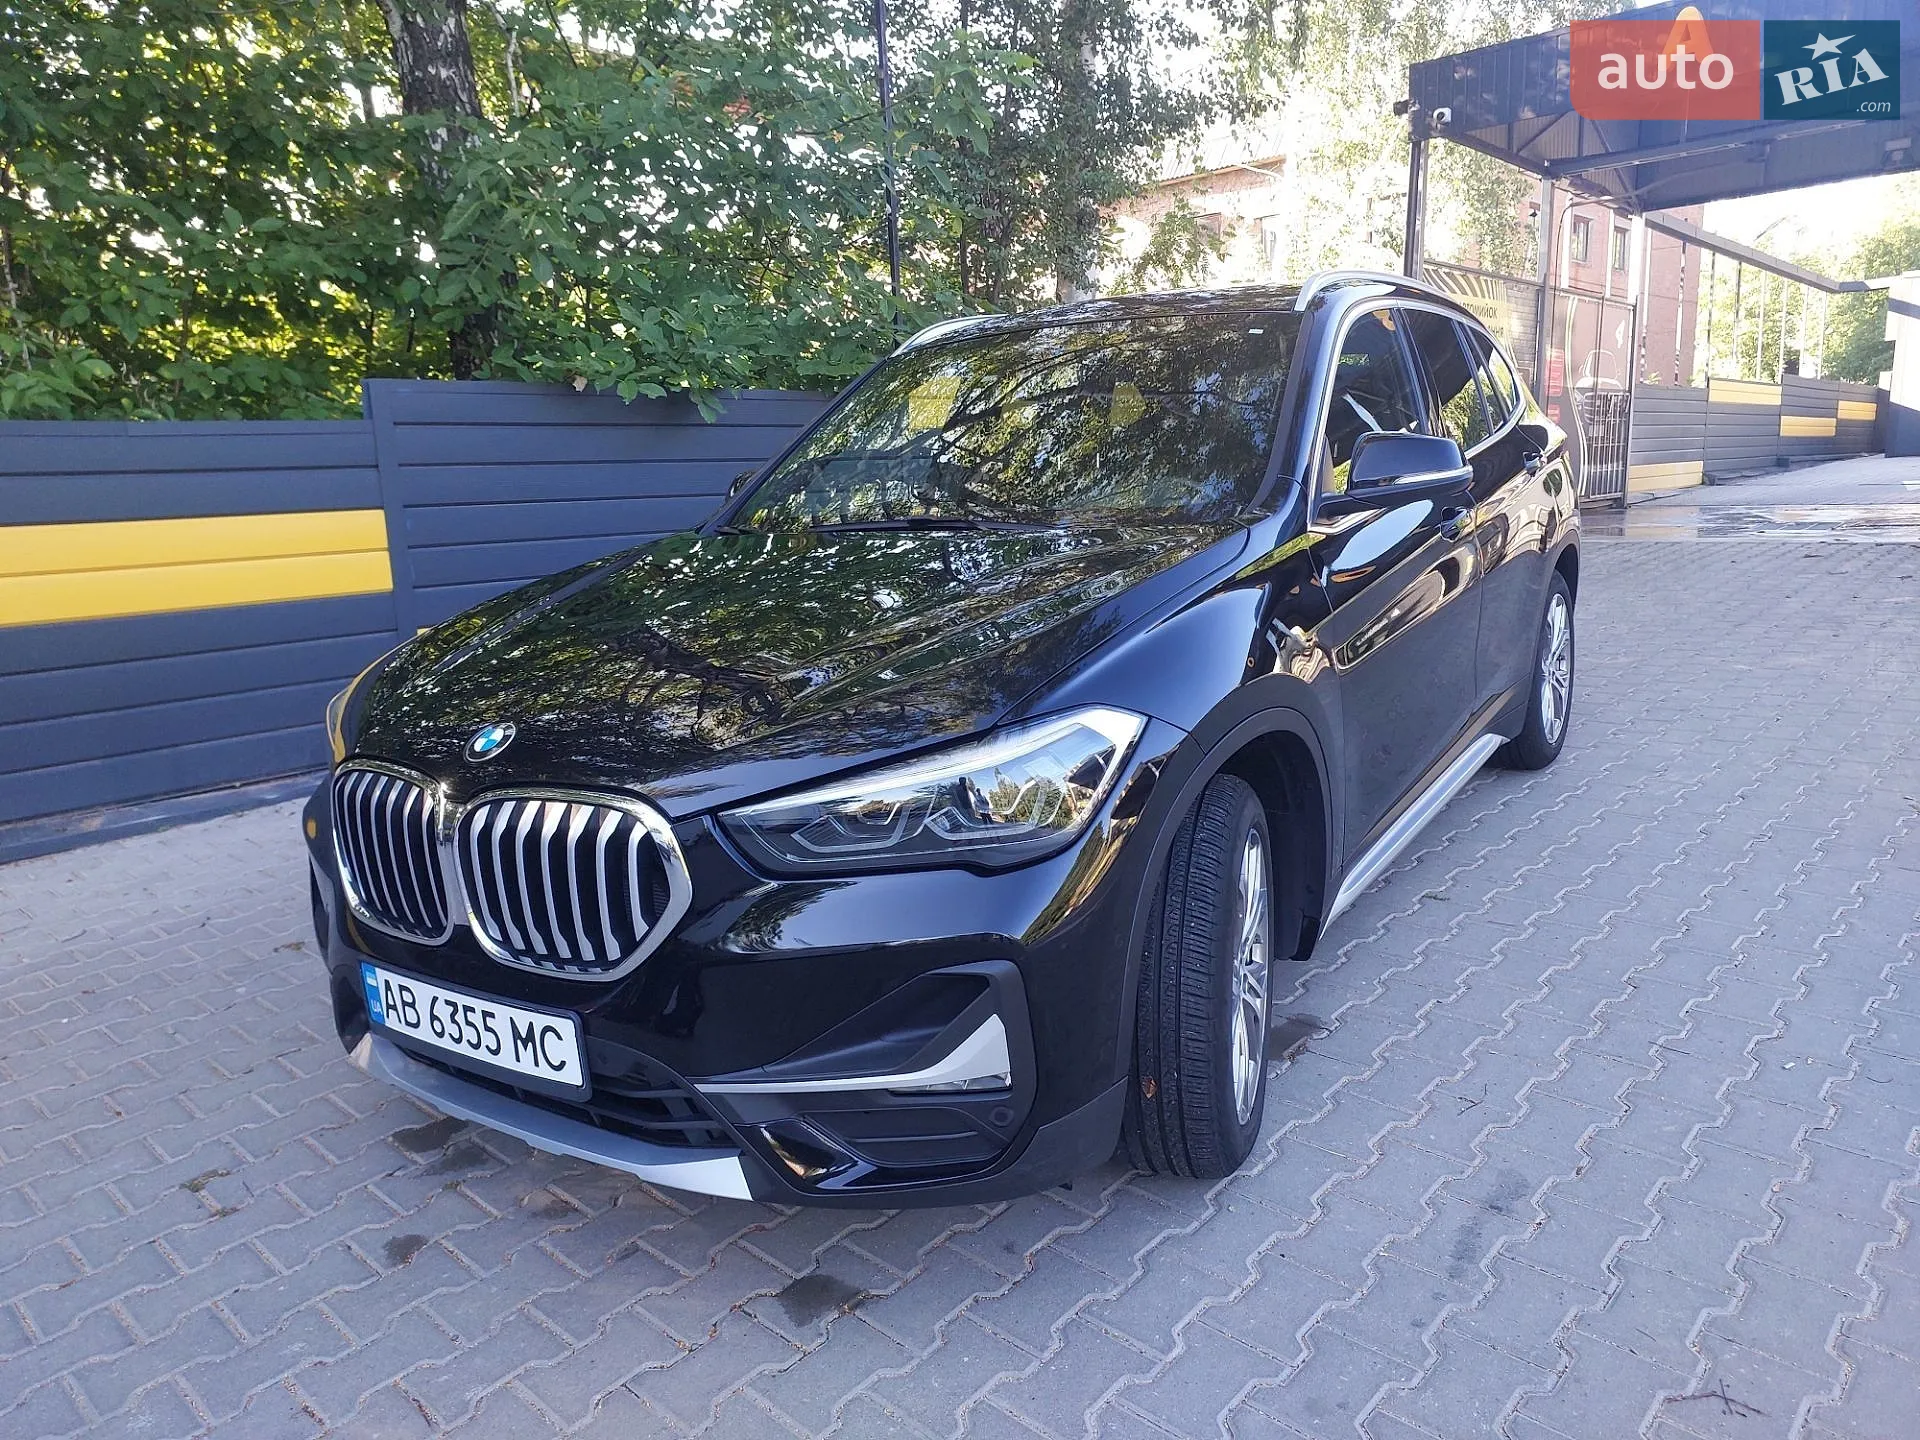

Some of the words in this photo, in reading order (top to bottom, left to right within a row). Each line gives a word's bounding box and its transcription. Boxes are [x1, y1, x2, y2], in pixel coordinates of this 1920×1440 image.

[371, 1001, 383, 1015] UA
[383, 979, 421, 1029] AB
[429, 996, 502, 1056] 6355
[509, 1016, 567, 1072] MC
